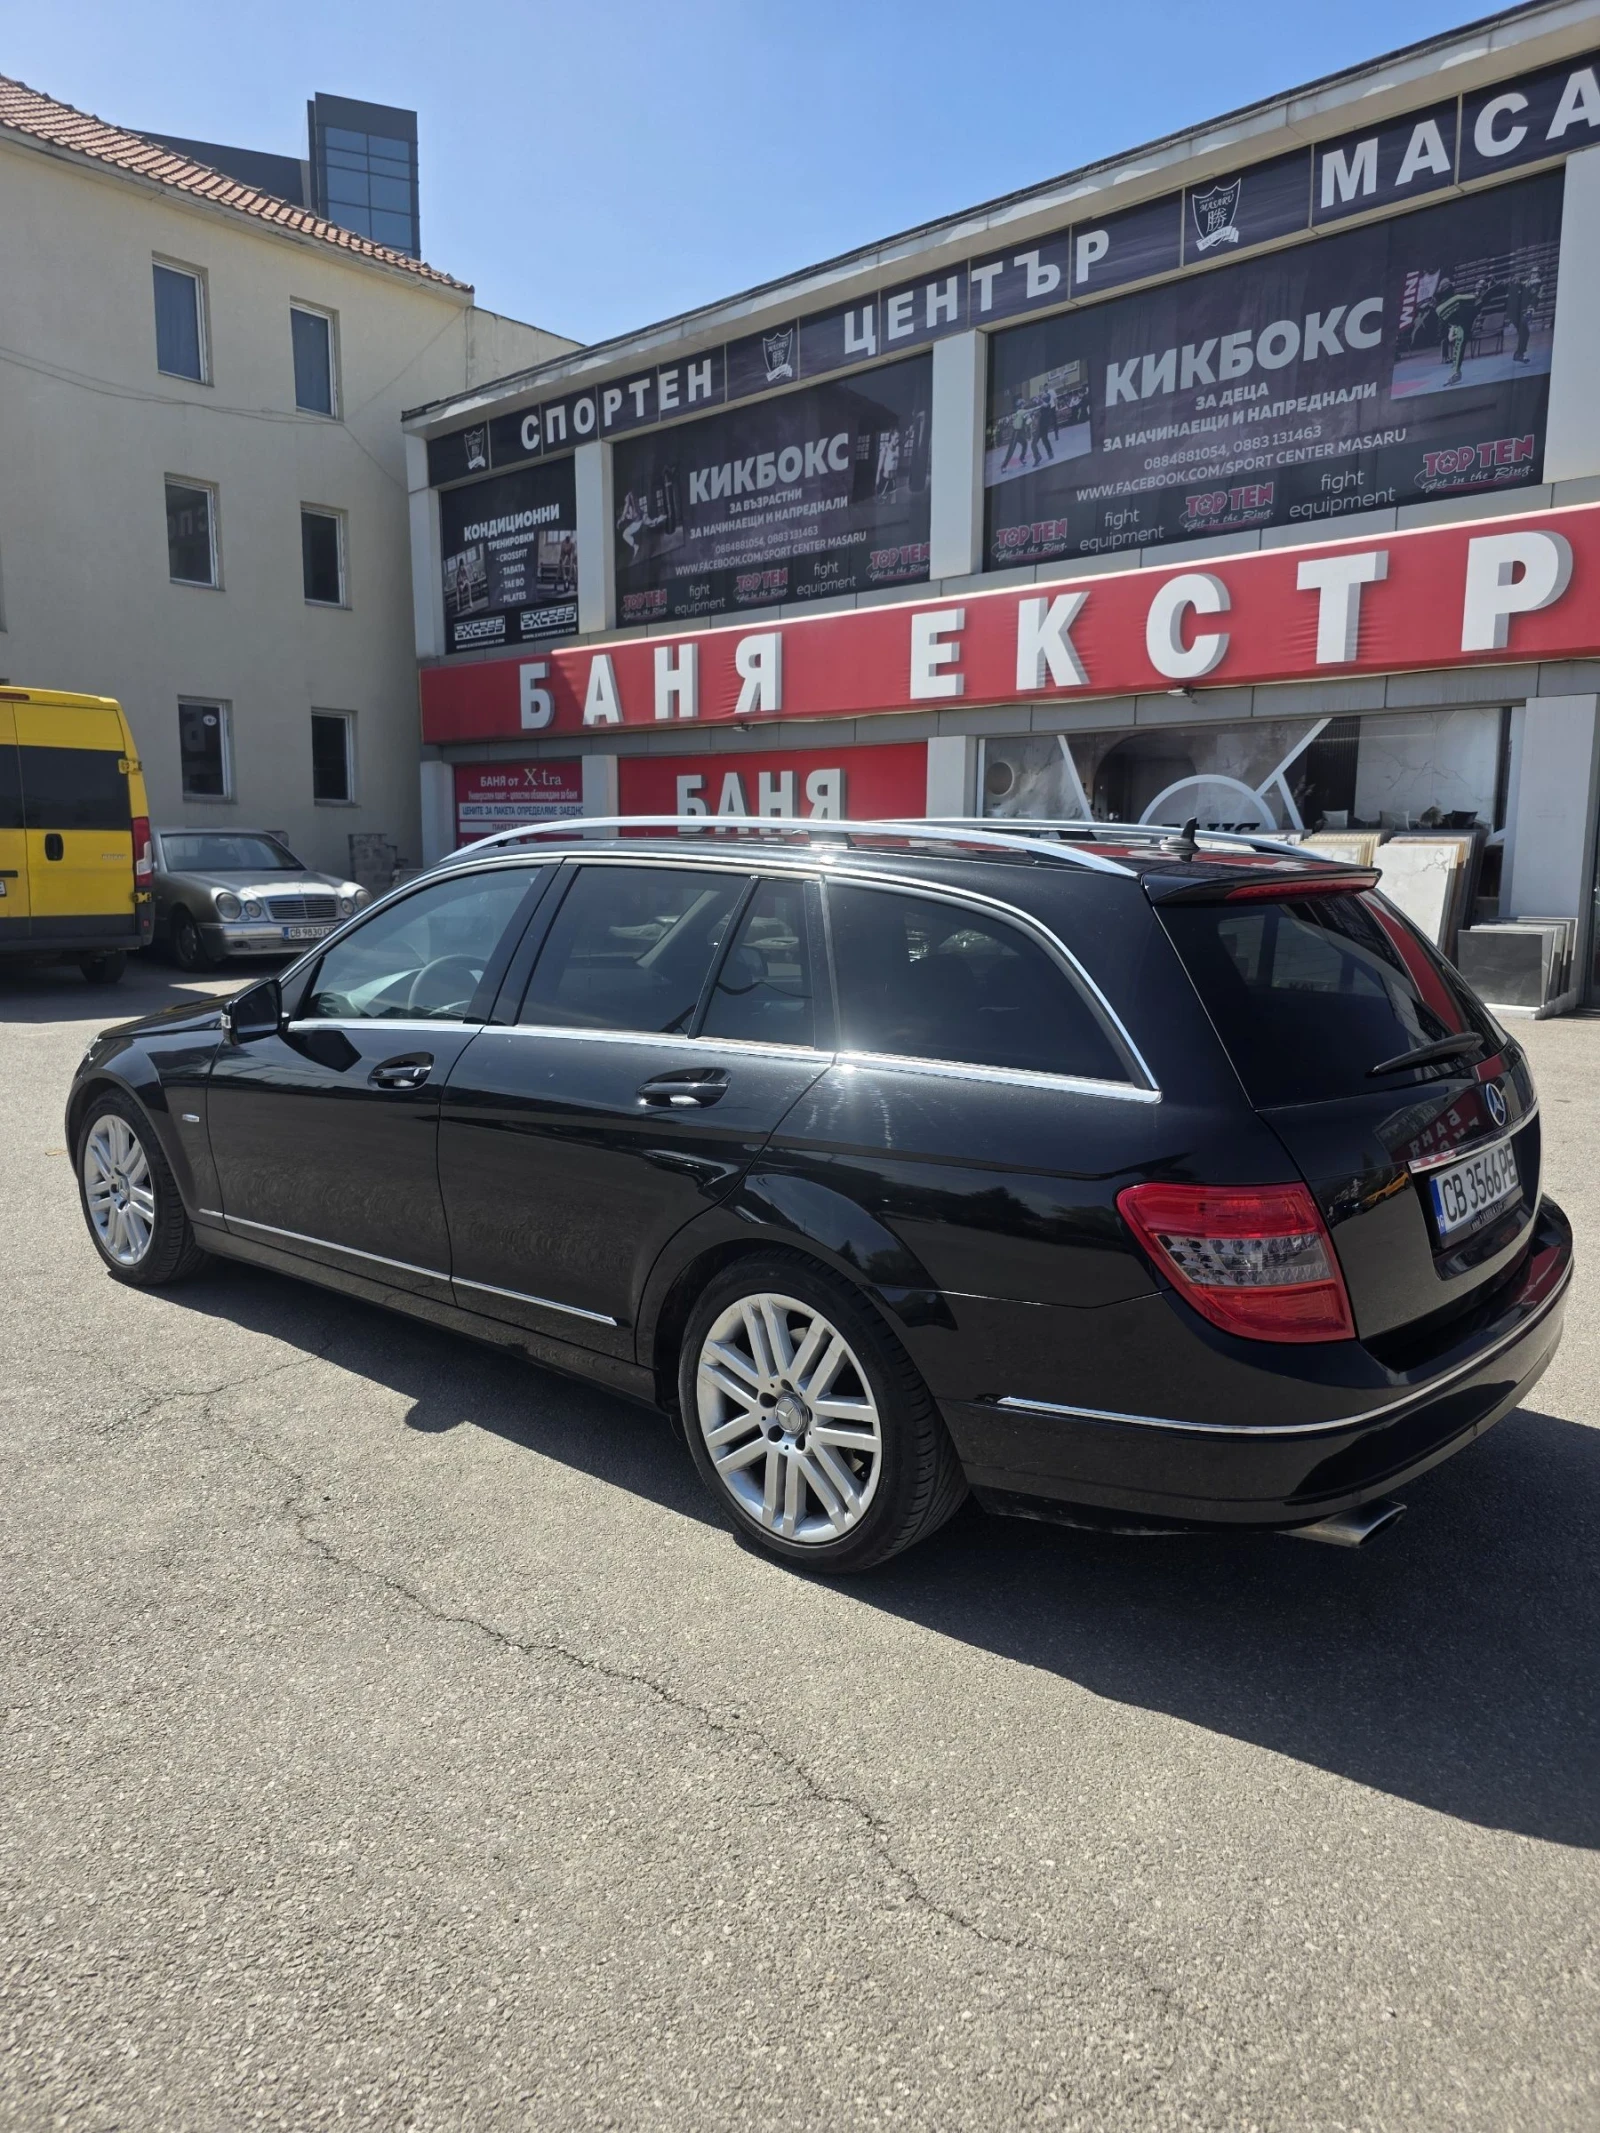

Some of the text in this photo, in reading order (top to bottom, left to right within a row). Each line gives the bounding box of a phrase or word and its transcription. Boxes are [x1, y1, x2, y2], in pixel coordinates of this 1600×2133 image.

[521, 359, 712, 450] СПОРТЕН
[844, 230, 1109, 356] ЦЕНТЪР
[1105, 297, 1384, 407] КИКБОКС
[1195, 382, 1269, 411] ЗА ДЕЦА
[1103, 382, 1377, 452] ЗА НАЧИНАЕЩИ И НАПРЕДНАЛИ
[1144, 425, 1322, 470] 0884881054, 0883 131463
[1423, 434, 1534, 478] TOP TEN
[689, 433, 849, 505] КИКБОКС
[1076, 428, 1407, 501] WWW.FACEBOOK.COM/SPORT CENTER MASARU
[1321, 469, 1365, 494] fight
[729, 488, 802, 514] ЗА ВЪЗРАСТНИ
[1185, 481, 1274, 518] TOP TEN
[1289, 487, 1396, 518] equipment
[464, 503, 560, 541] КОНДИЦИОННИ
[690, 496, 848, 539] ЗА НАЧИНАЕЩИ И НАПРЕДНАЛИ
[996, 517, 1068, 549] TOP TEN
[1104, 507, 1140, 530] fight
[487, 532, 534, 551] ТРЕНИРОВКИ
[792, 540, 826, 554] CENTER
[827, 531, 867, 548] MASARU
[1079, 525, 1165, 551] equipment
[814, 562, 839, 579] fight
[870, 548, 899, 570] TOP
[689, 583, 710, 600] fight
[796, 575, 856, 597] equipment
[455, 606, 575, 639] EXCESS EXCESS
[674, 597, 725, 617] equipment
[519, 530, 1572, 730] БАНЯ ЕКСТР
[480, 768, 562, 788] БАНЯ от X-tra
[676, 768, 846, 835] БАНЯ
[1442, 1173, 1468, 1222] CB
[1465, 1153, 1502, 1209] 3566
[1497, 1142, 1517, 1190] PE
